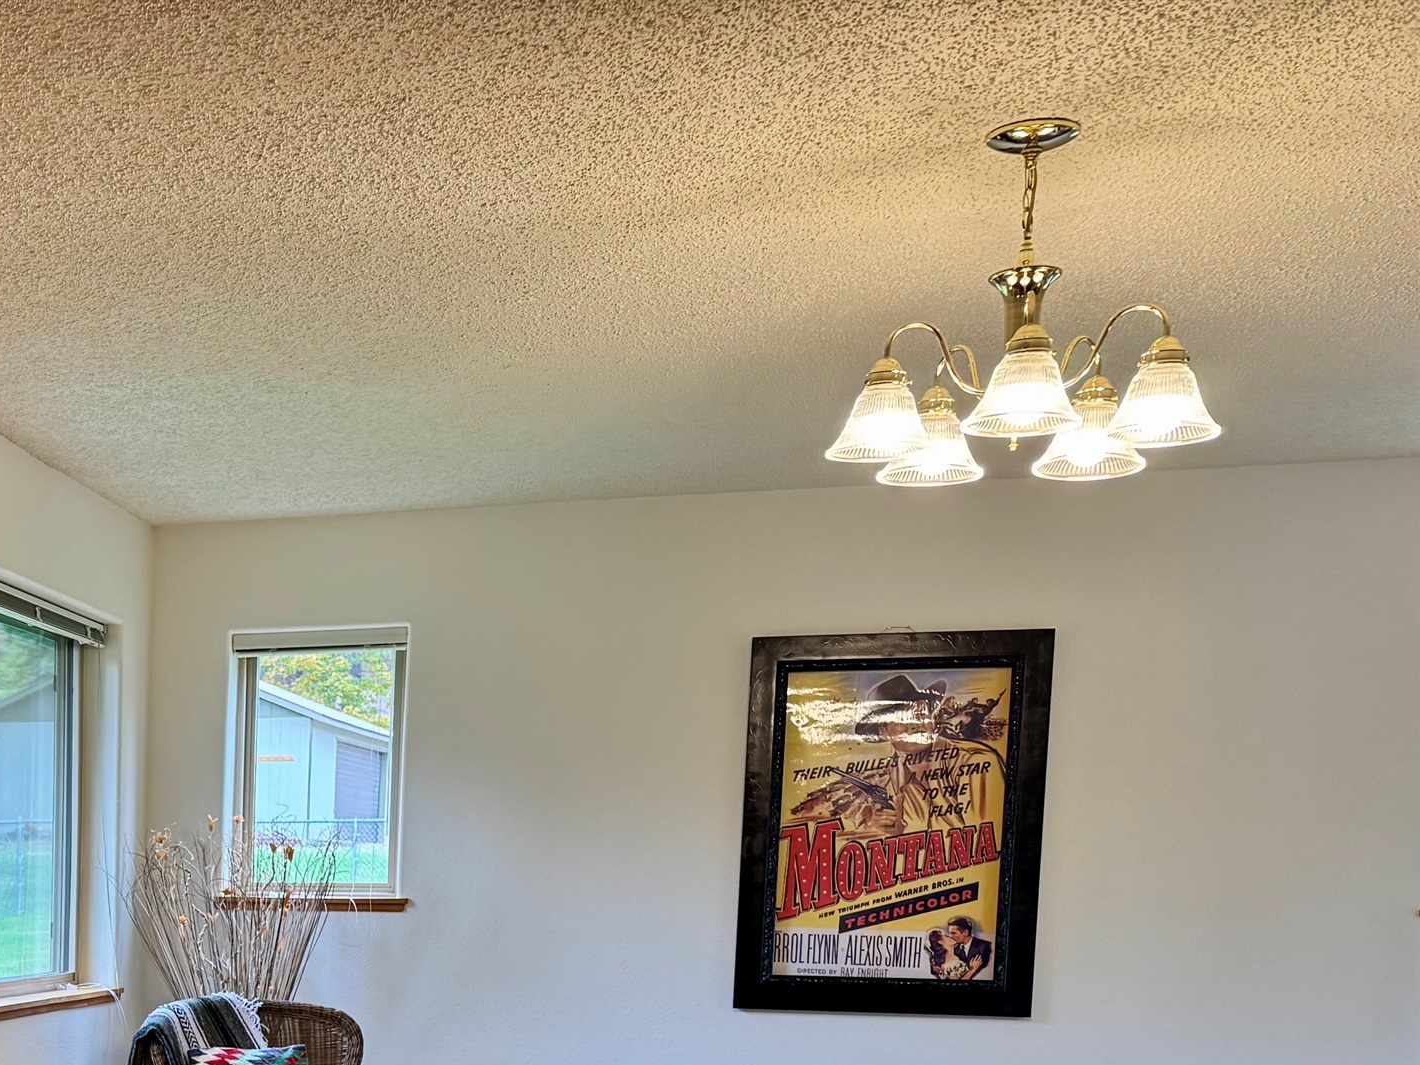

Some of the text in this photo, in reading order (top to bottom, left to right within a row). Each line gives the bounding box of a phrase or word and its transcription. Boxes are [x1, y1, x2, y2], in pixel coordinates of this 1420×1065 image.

[793, 747, 960, 783] THEIR BULLETS RIVETED
[908, 761, 991, 782] A NEW STAR
[922, 783, 969, 801] TO THE
[930, 800, 971, 818] FLAG!
[775, 818, 1000, 922] MONTANA
[818, 877, 964, 919] NEW TRIUMPH FROM WARNER BROS. IN
[845, 890, 973, 929] TECHNICOLOR
[773, 930, 923, 969] RROL FLYNN ALEXIS SMITH
[796, 967, 827, 975] DIRECTED
[840, 967, 855, 977] RAY
